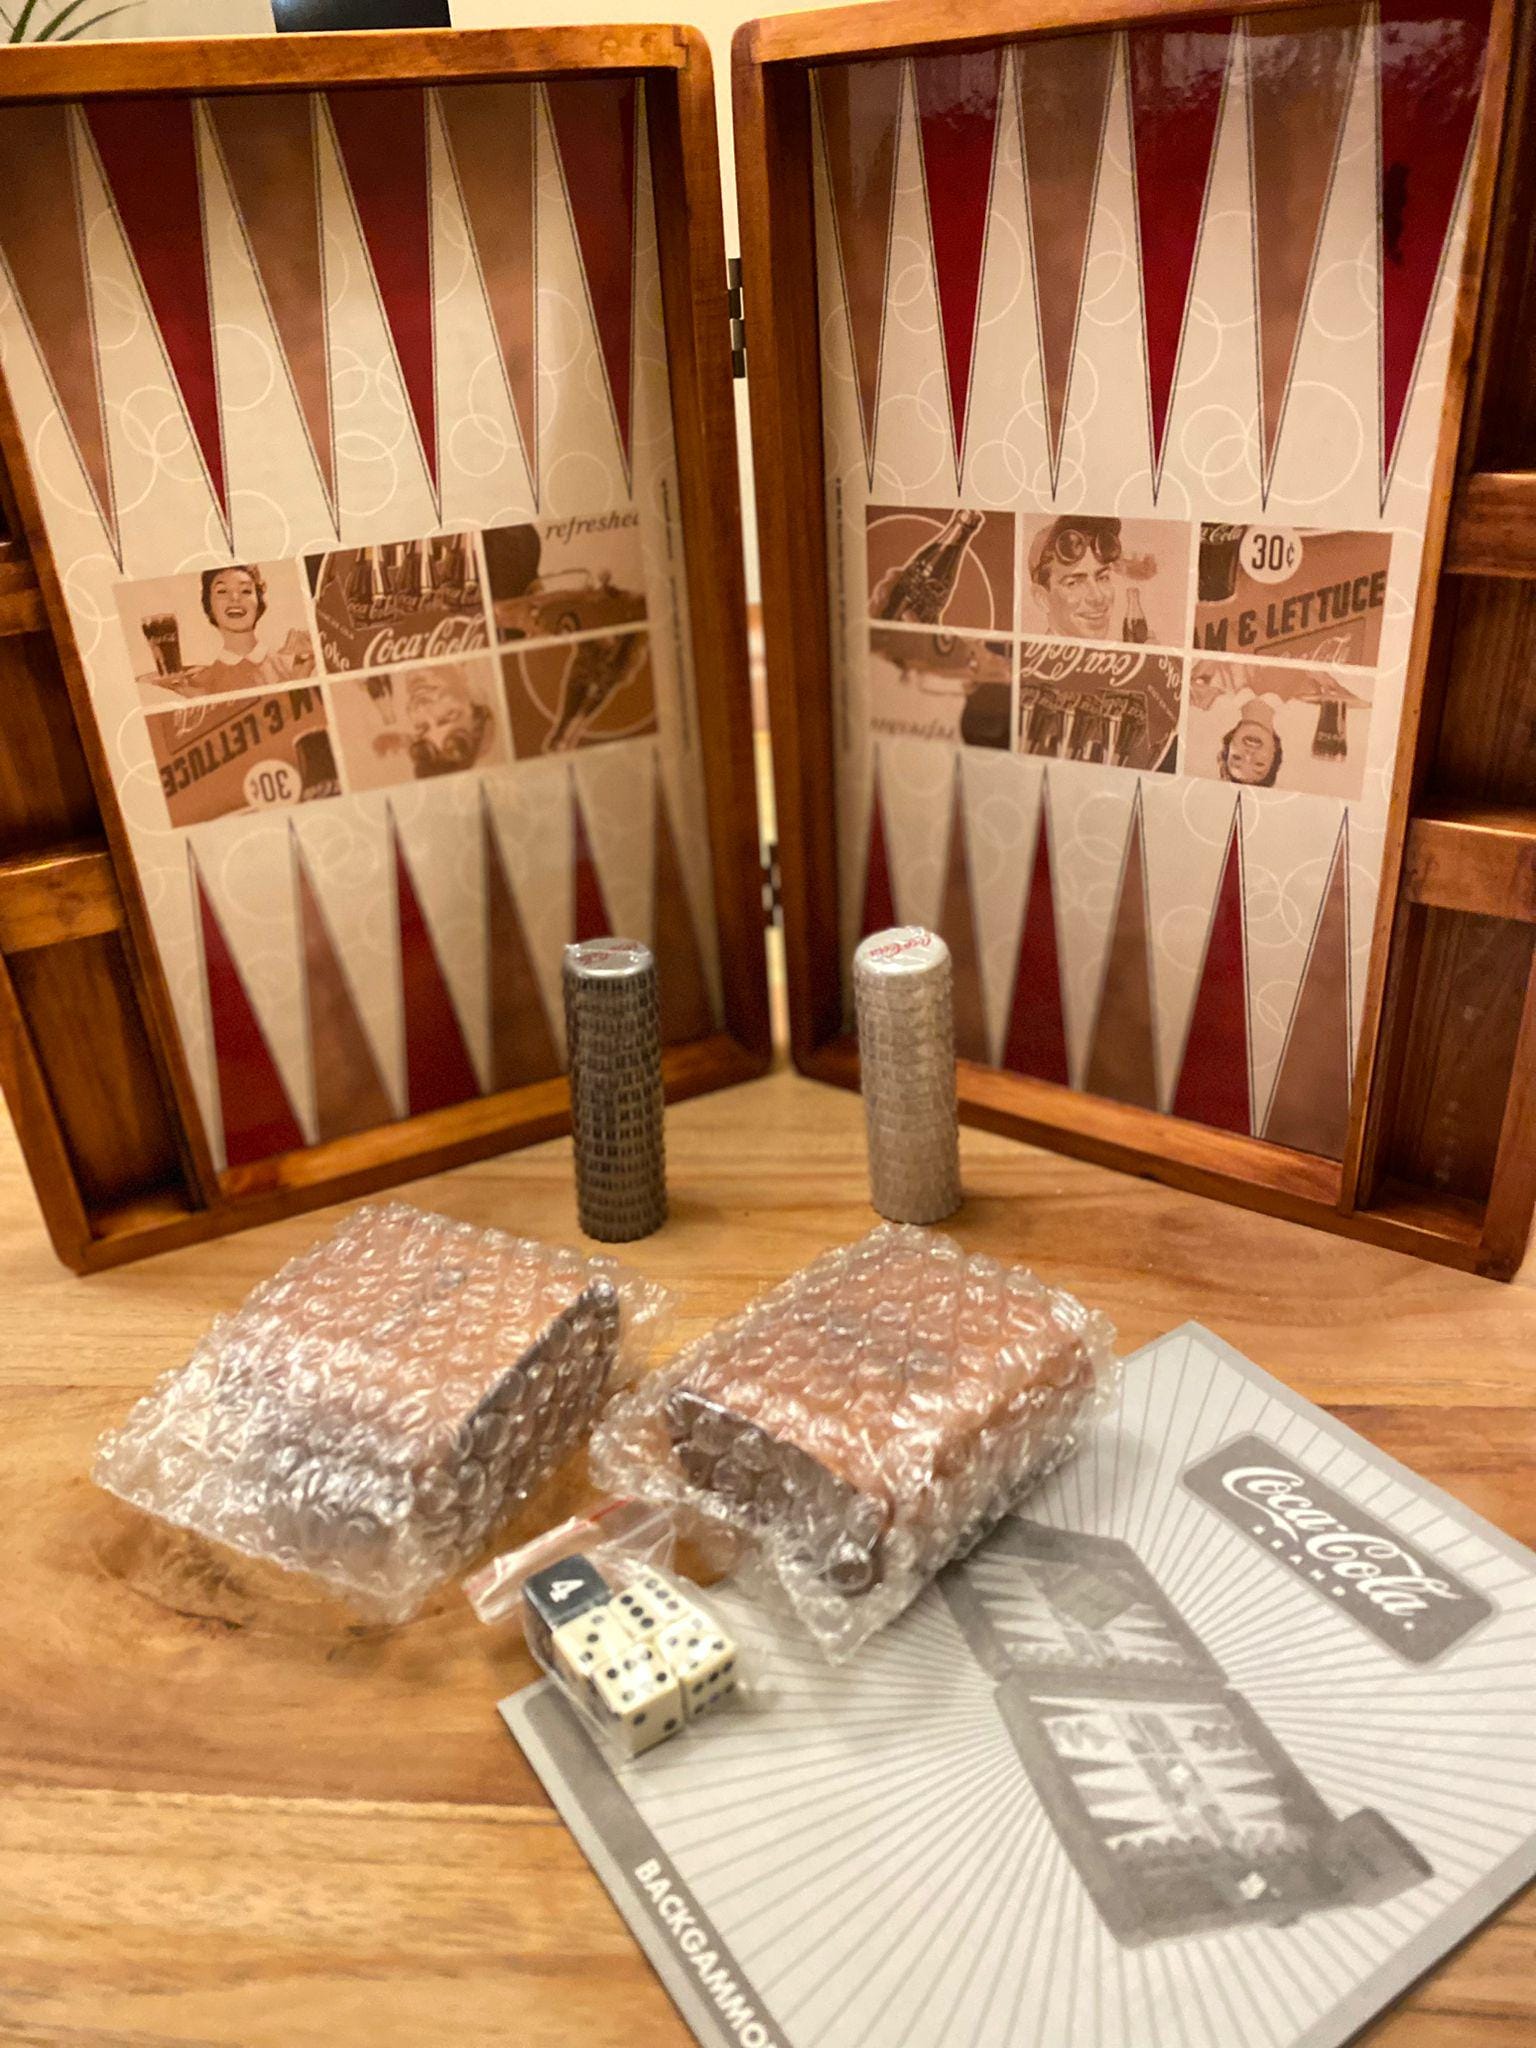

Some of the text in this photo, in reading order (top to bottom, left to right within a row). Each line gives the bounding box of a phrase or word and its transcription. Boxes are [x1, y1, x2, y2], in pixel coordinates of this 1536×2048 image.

[1252, 534, 1295, 569] 30¢
[1266, 570, 1388, 639] LETTUCE
[159, 713, 260, 798] LETTUCE
[1221, 1465, 1463, 1616] Coca-Cola
[549, 1578, 585, 1603] 4
[634, 1857, 778, 2048] BACKGAMMO
